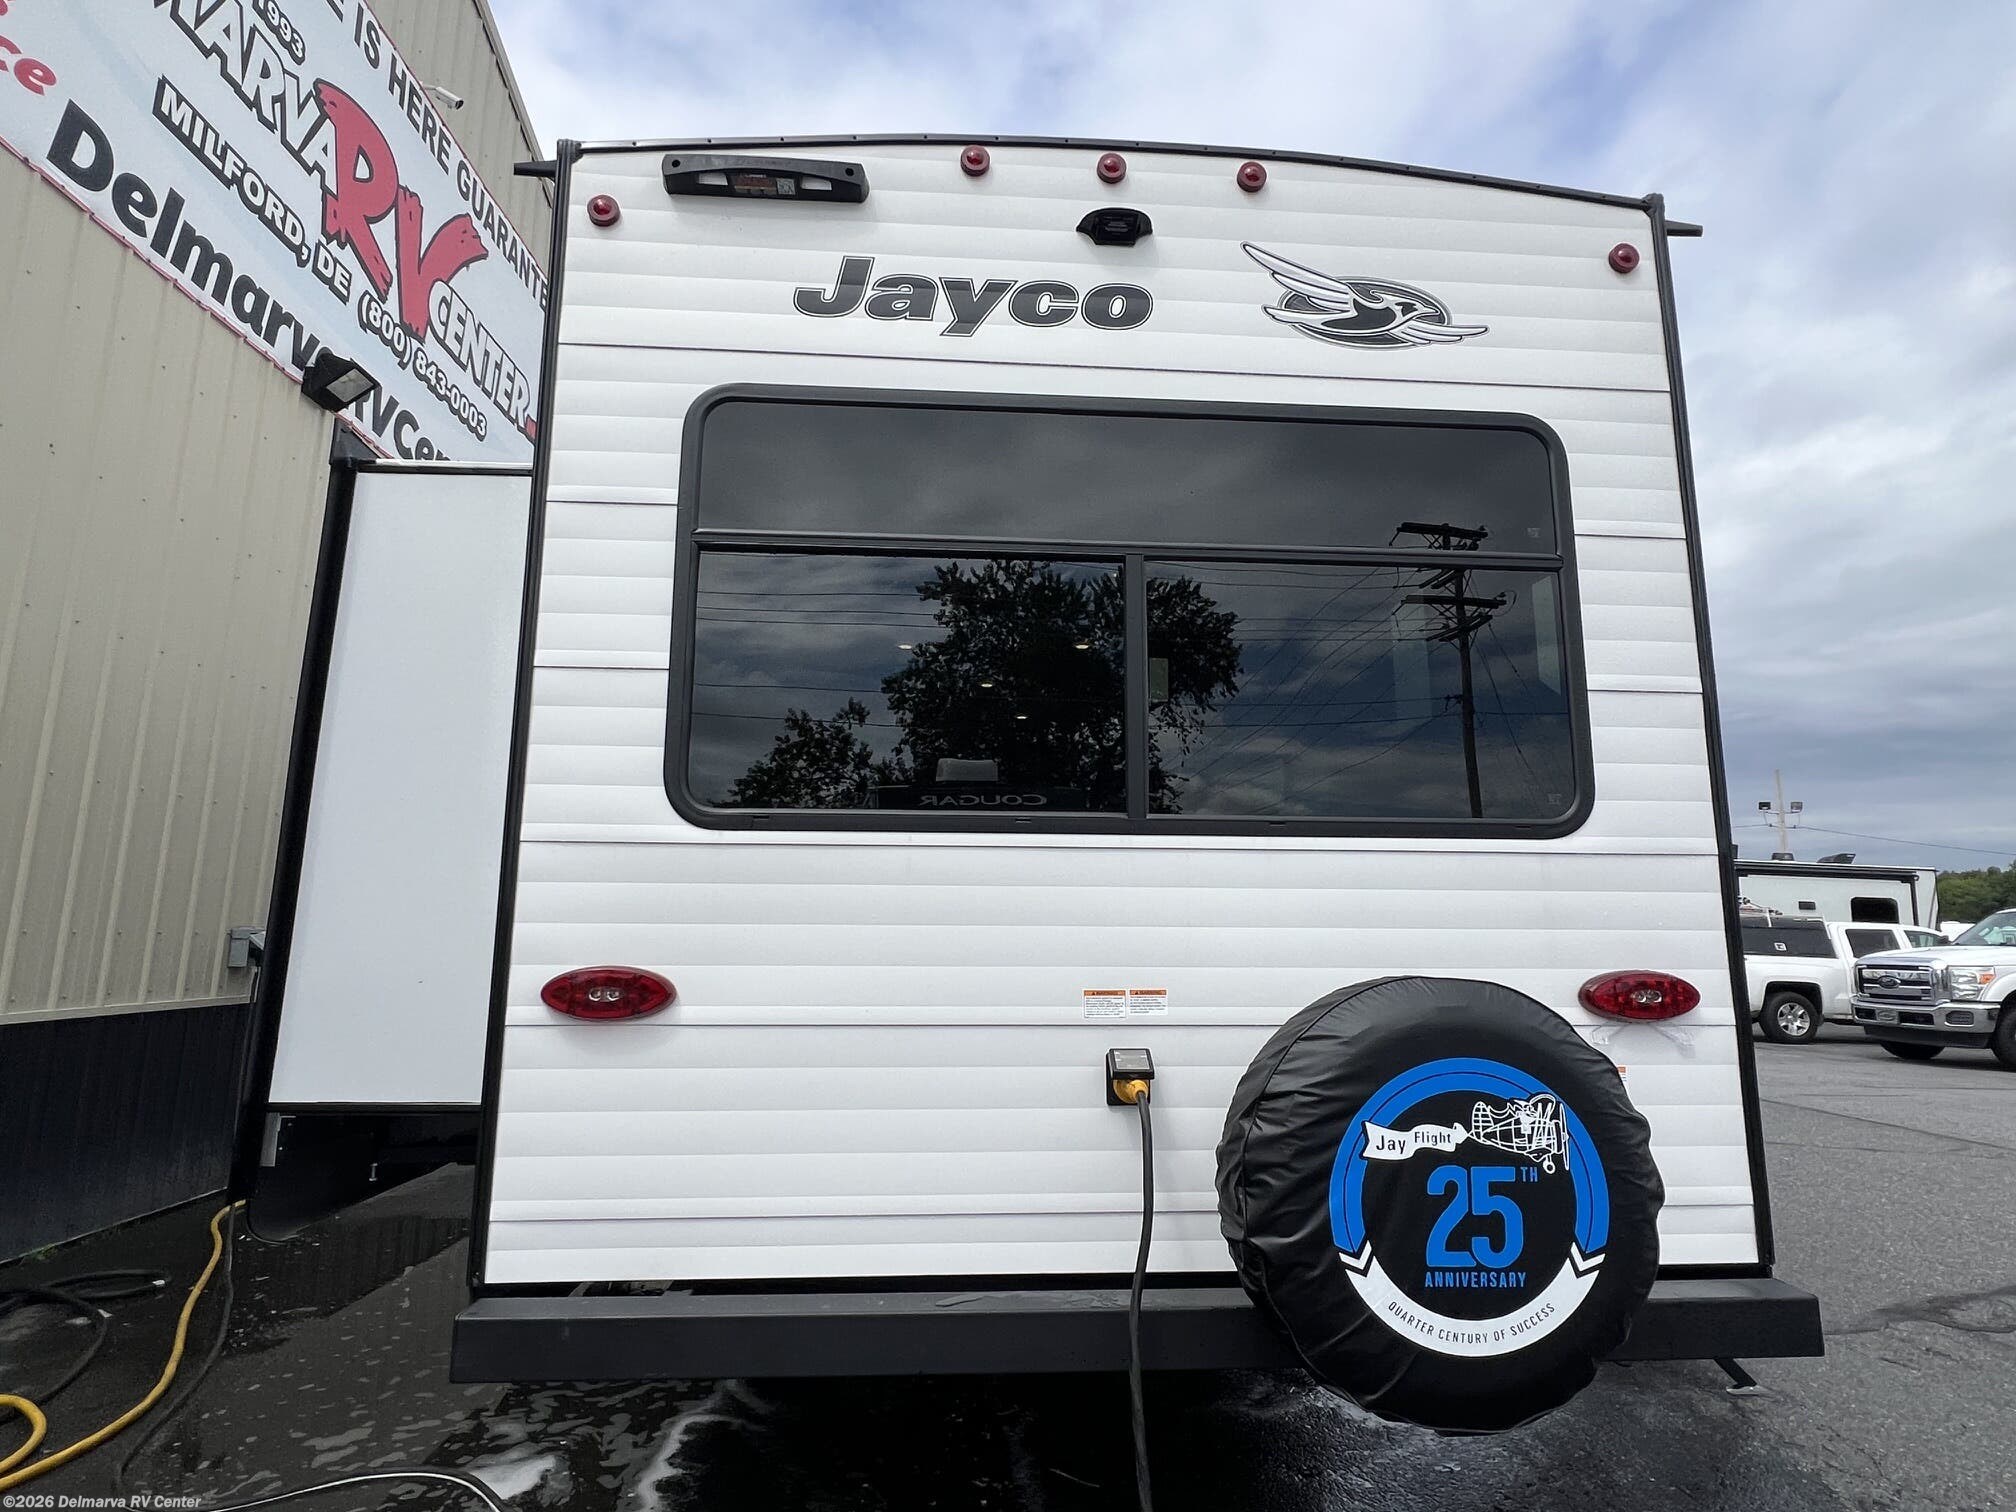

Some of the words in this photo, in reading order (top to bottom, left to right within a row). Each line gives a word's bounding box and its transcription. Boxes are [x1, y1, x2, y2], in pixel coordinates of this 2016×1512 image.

[354, 4, 381, 69] IS
[388, 53, 451, 175] HERE
[153, 74, 311, 268] MILFORD,
[312, 240, 351, 305] DE
[358, 290, 413, 371] (800)
[412, 346, 488, 442] 843-0003
[312, 78, 489, 345] RV
[428, 280, 532, 432] CENTER
[793, 255, 1154, 338] Jayco
[1376, 1134, 1407, 1155] Jay
[1414, 1131, 1452, 1148] Flight
[1424, 1271, 1527, 1288] ANNIVERSARY
[1388, 1300, 1434, 1337] QUARTER
[1438, 1327, 1488, 1344] CENTURY
[1493, 1330, 1506, 1342] OF
[1510, 1302, 1556, 1337] SUCCESS
